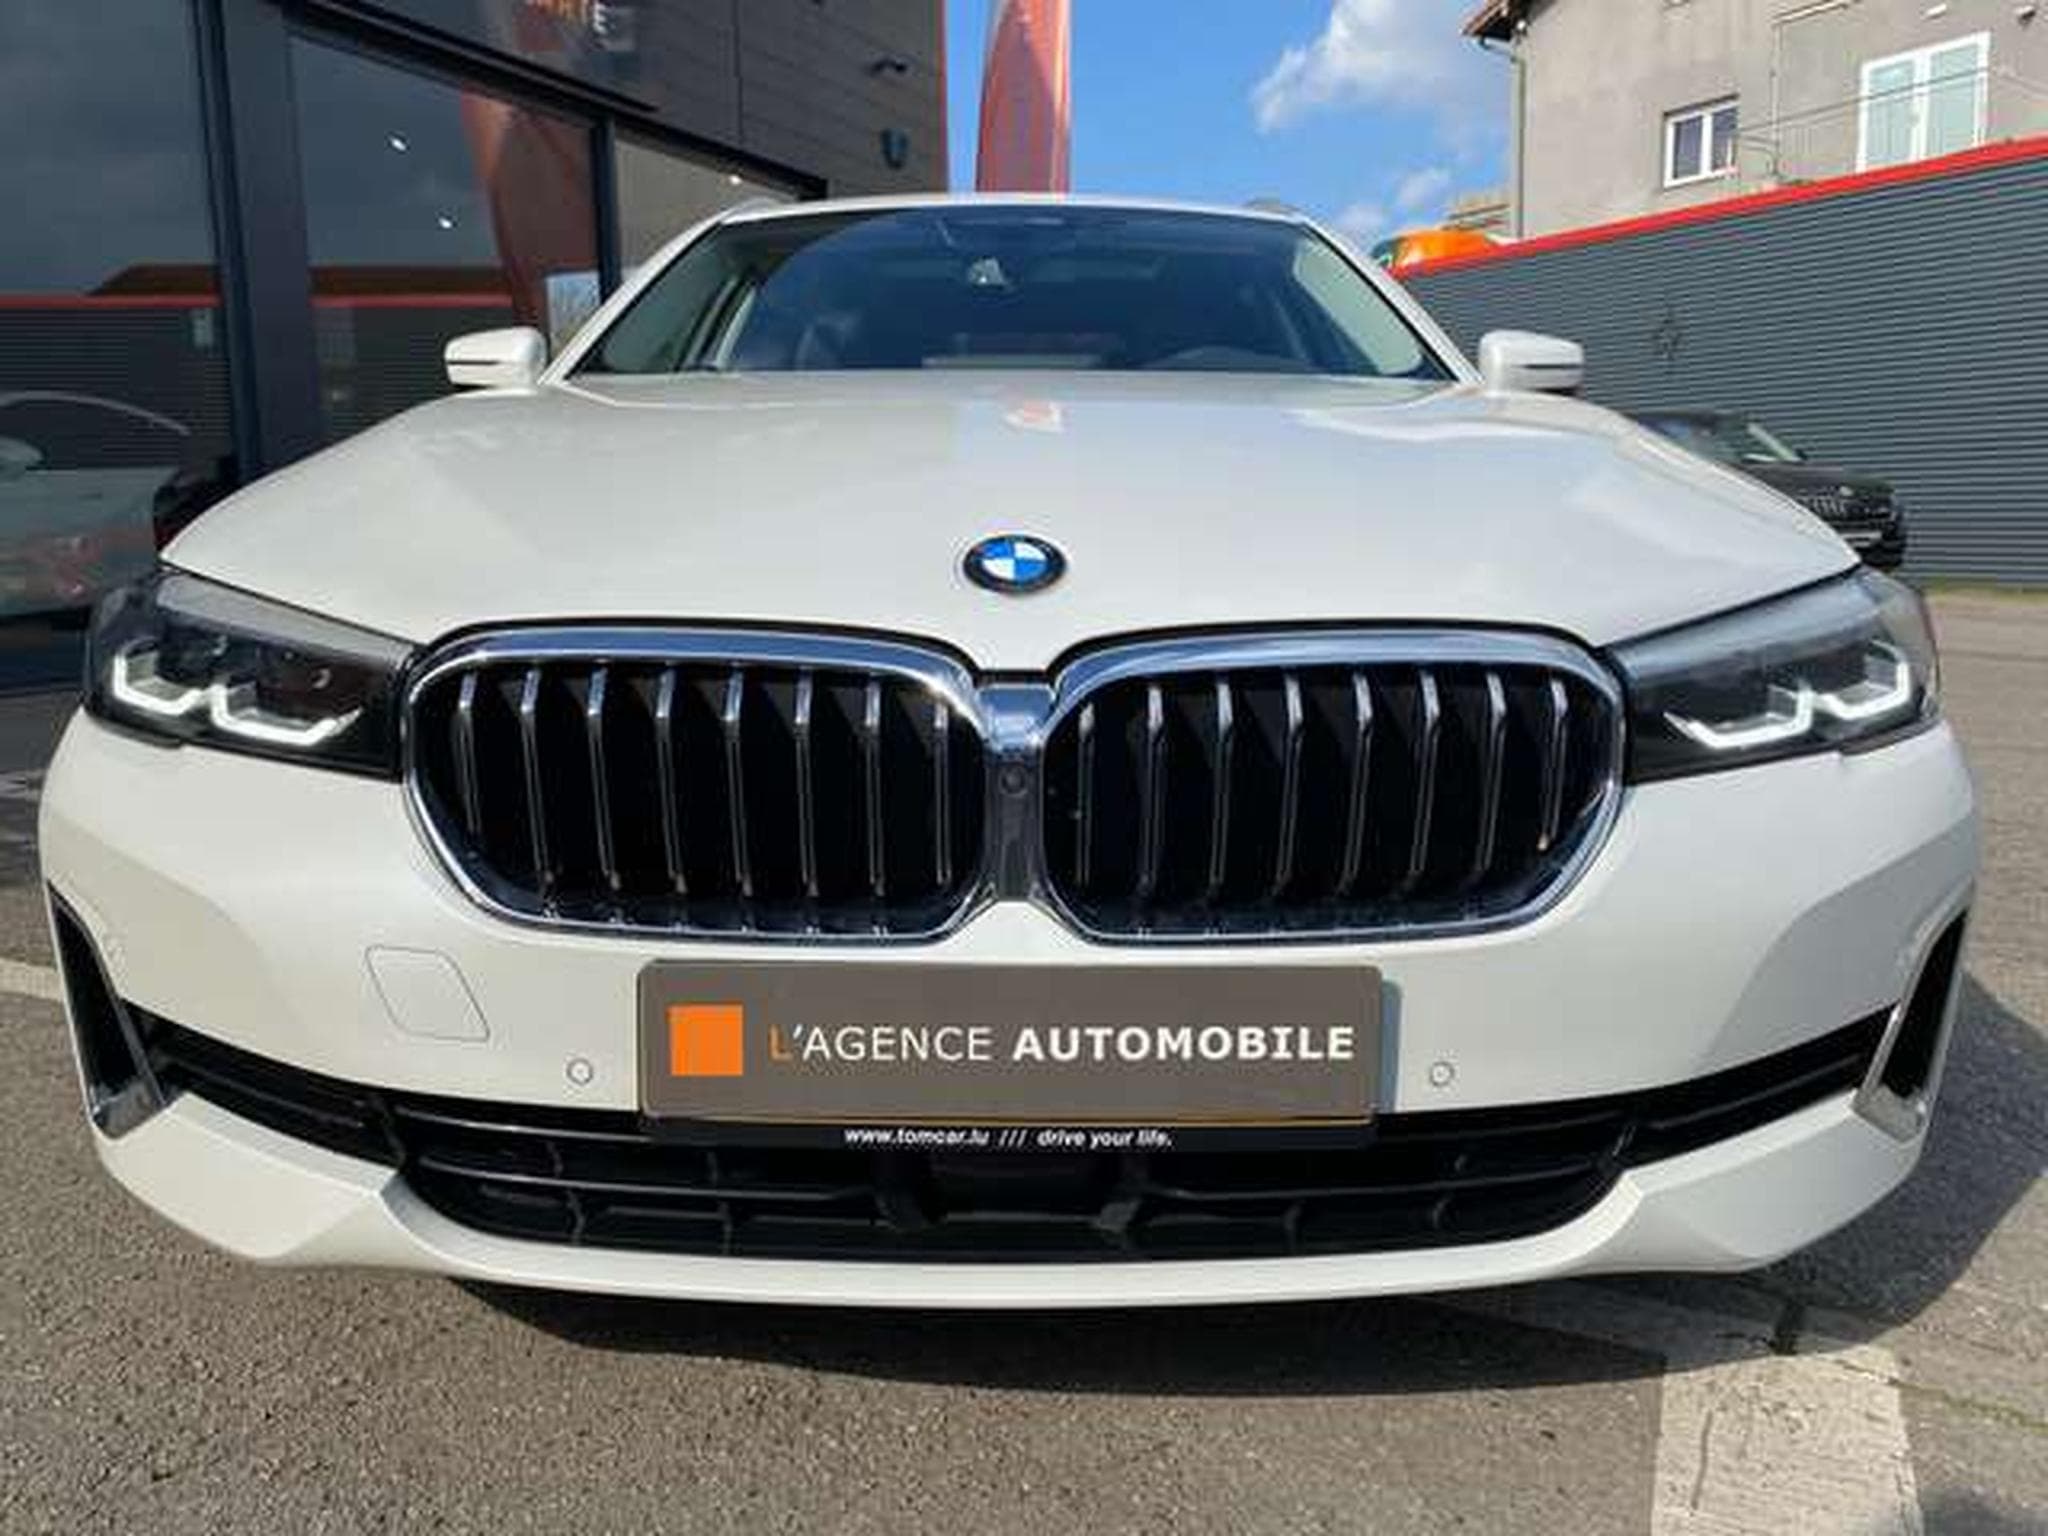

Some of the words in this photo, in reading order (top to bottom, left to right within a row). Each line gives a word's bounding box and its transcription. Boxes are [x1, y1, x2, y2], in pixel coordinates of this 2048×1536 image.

[844, 1127, 989, 1146] www.tomcar.lu
[1036, 1128, 1086, 1147] drive
[1090, 1130, 1132, 1149] your
[1136, 1128, 1173, 1147] life.
